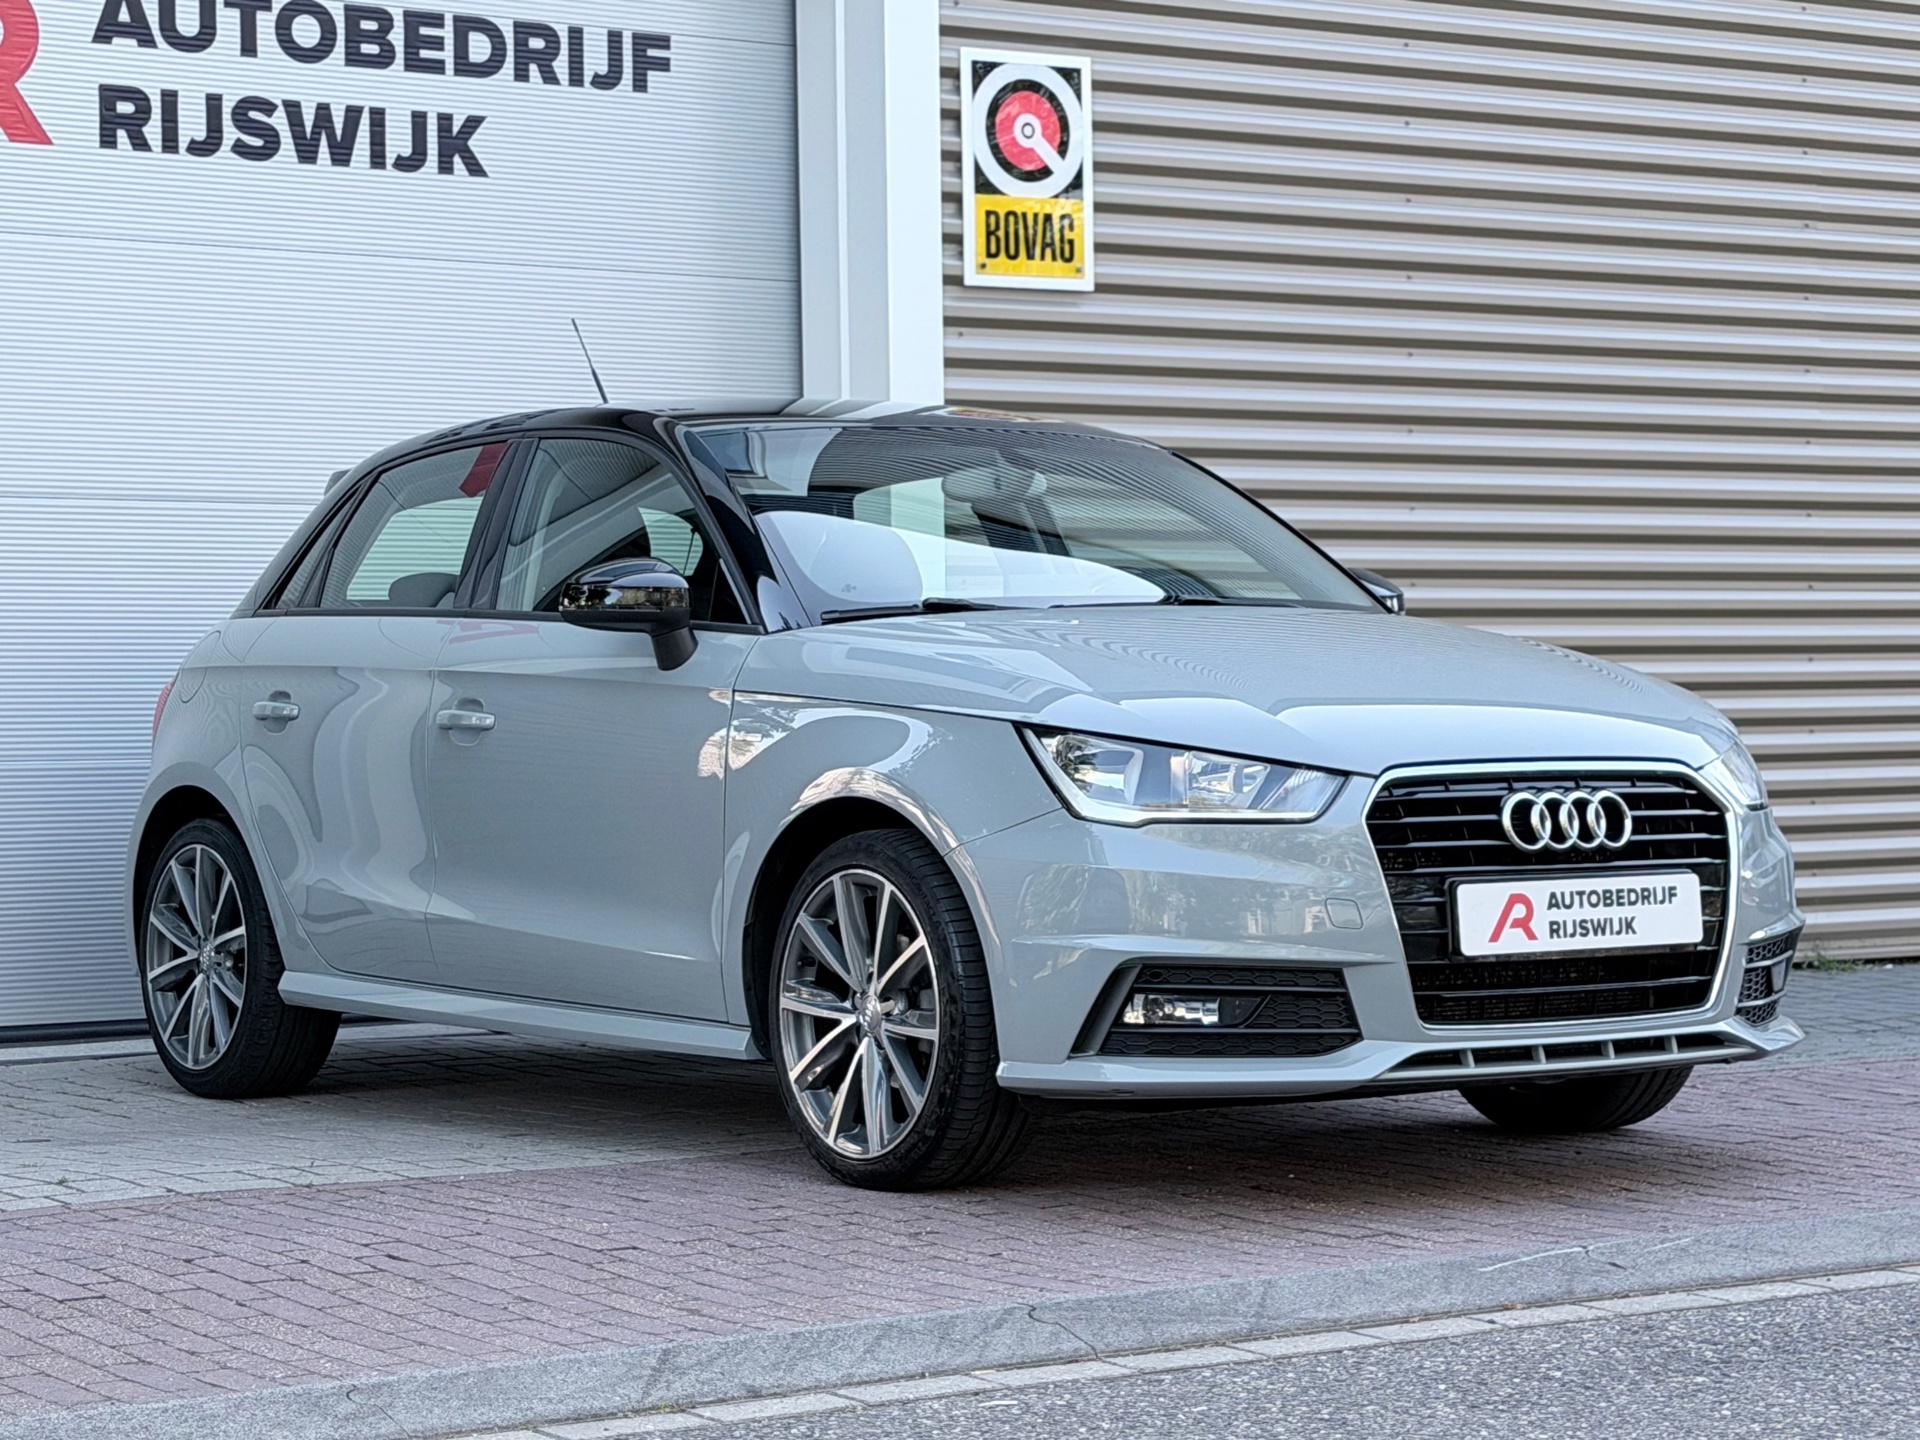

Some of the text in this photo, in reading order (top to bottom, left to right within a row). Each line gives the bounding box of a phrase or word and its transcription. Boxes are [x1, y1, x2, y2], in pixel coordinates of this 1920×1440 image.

[91, 0, 671, 93] AUTOBEDRIJF
[99, 84, 489, 178] RIJSWIJK
[985, 210, 1075, 263] BOVAG
[1546, 885, 1678, 911] AUTOBEDRIJF
[1548, 916, 1637, 939] RIJSWIJK
